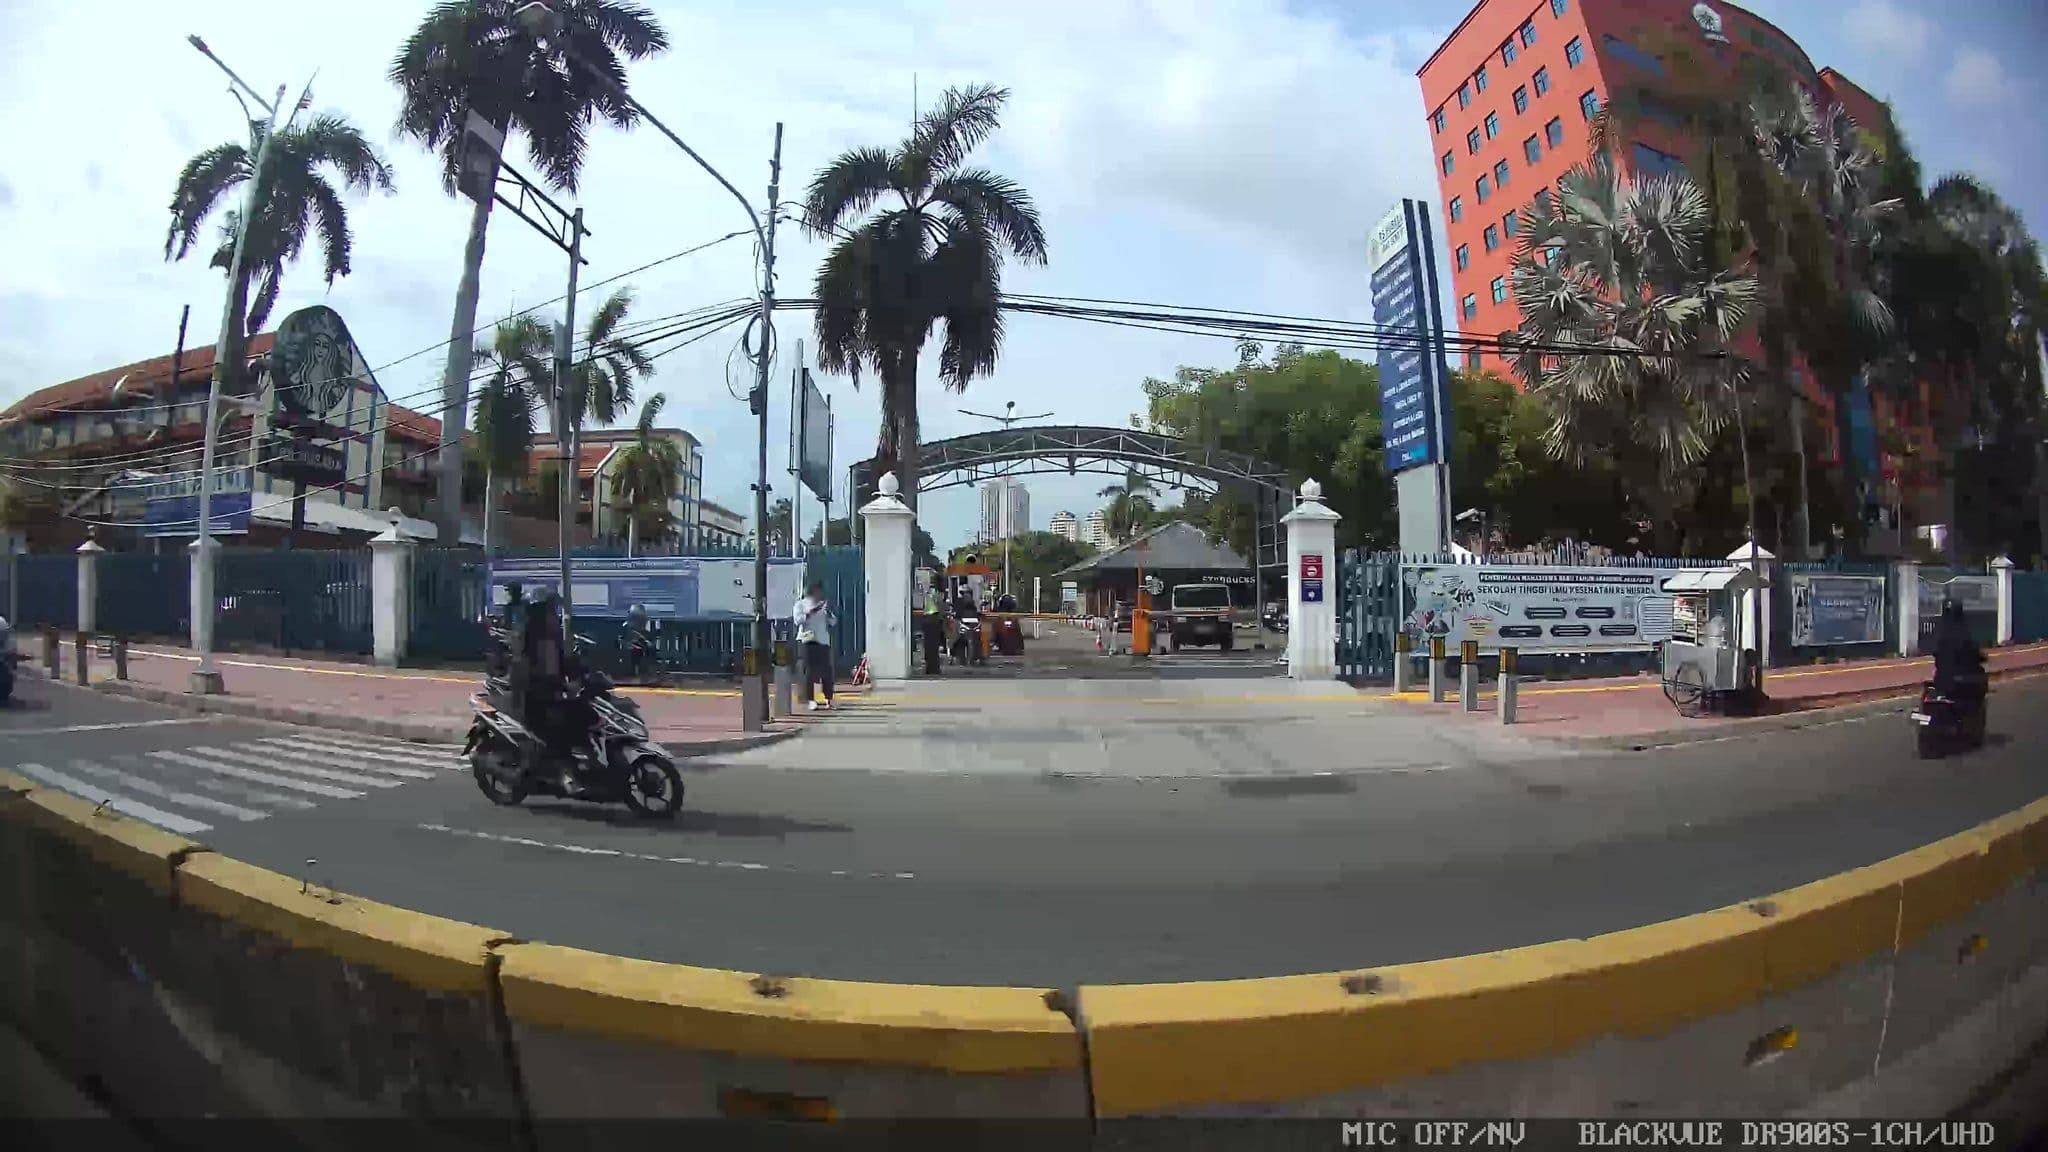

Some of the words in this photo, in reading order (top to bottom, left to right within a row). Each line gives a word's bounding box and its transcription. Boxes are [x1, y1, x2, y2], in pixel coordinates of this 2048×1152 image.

[1202, 575, 1256, 584] STARBUCKS
[1477, 585, 1516, 594] SEKOLAH
[1519, 585, 1547, 594] TINGGI
[1549, 585, 1568, 594] ILMU
[1569, 585, 1614, 594] KESEHATAN
